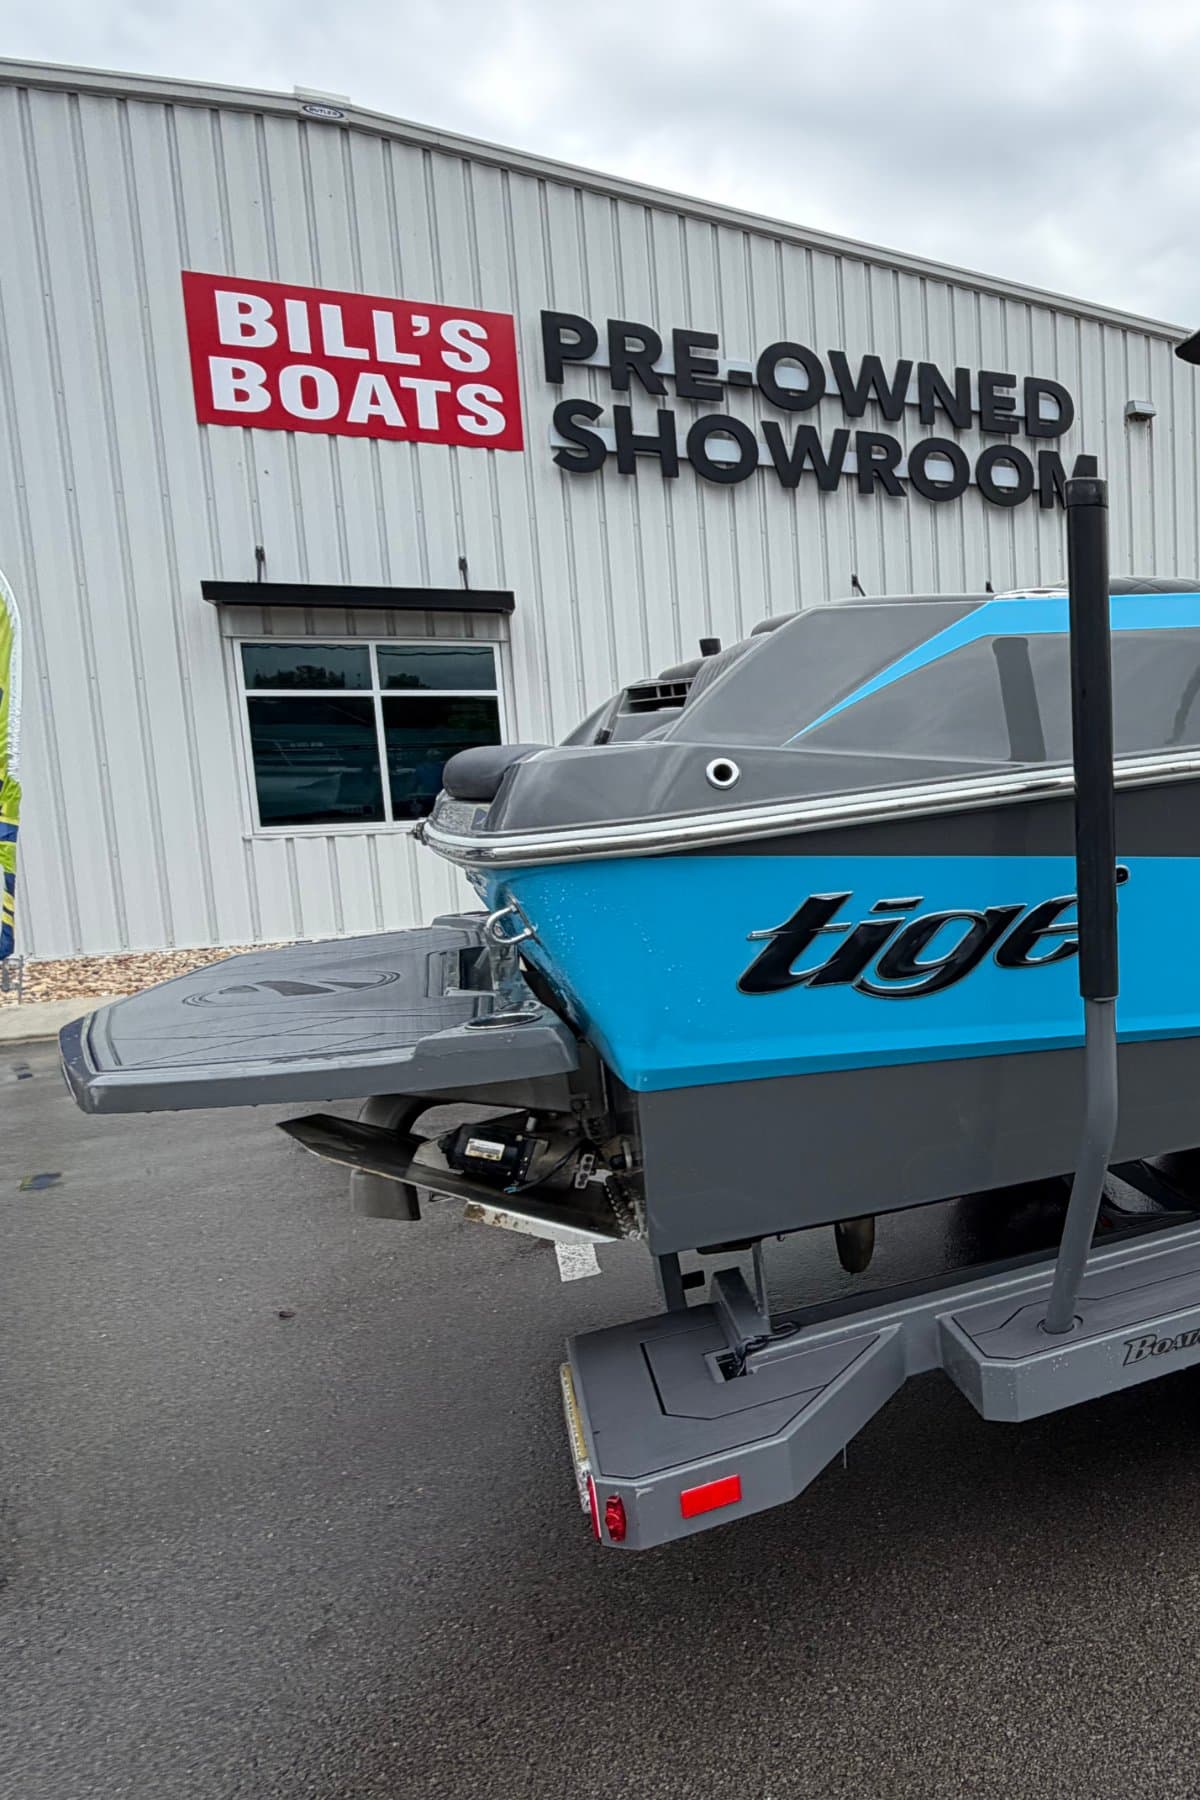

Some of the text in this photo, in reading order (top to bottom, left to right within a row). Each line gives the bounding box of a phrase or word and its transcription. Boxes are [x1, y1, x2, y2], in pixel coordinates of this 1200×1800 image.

[214, 290, 491, 373] BILL'S
[540, 310, 1075, 438] PRE-OWNED
[208, 356, 506, 436] BOATS
[552, 399, 1098, 509] SHOWROOM
